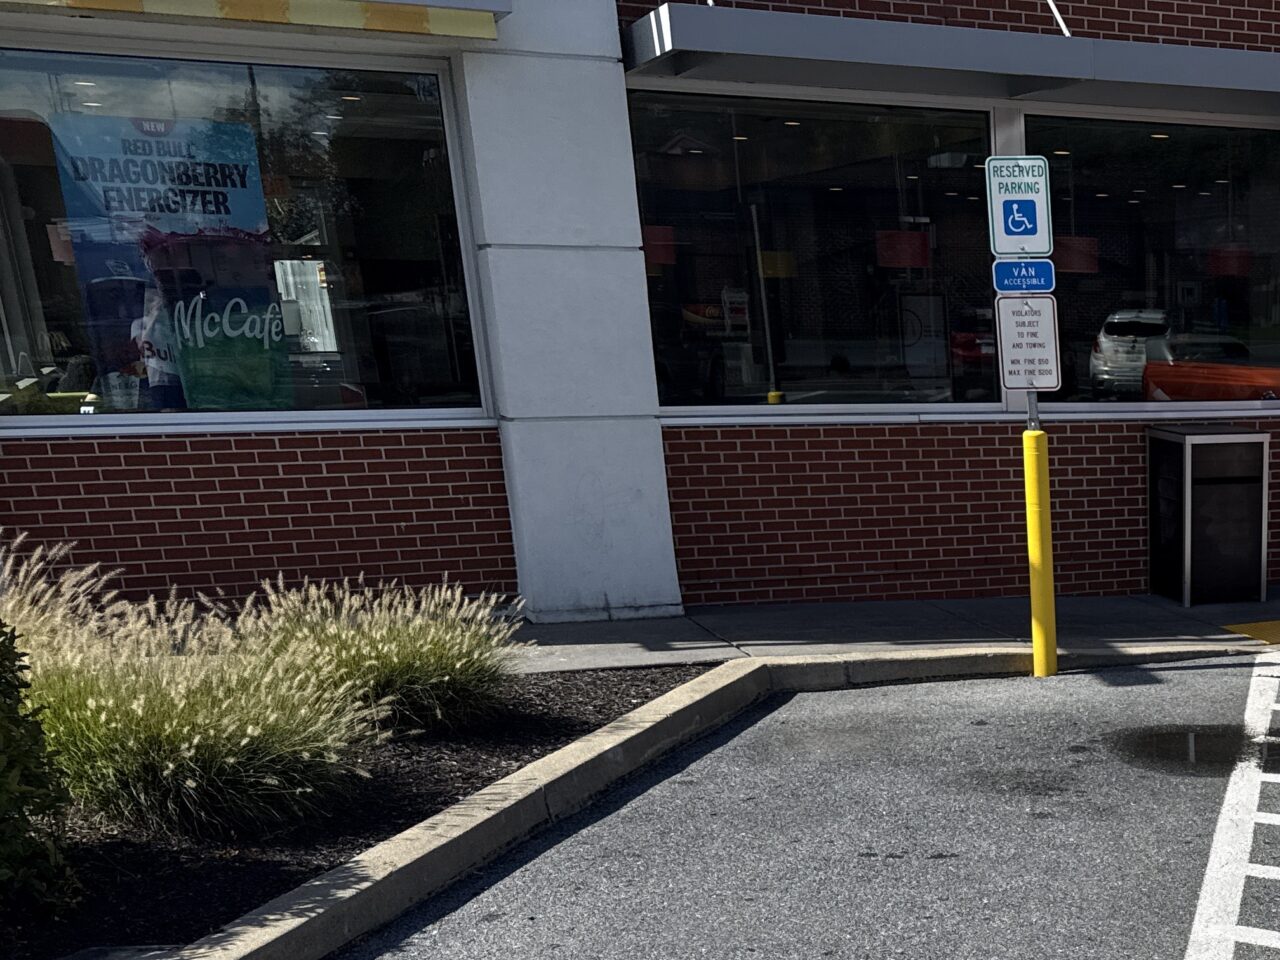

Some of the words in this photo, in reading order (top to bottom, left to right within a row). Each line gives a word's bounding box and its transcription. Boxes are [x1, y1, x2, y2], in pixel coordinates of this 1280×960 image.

[142, 120, 165, 132] NEW
[121, 138, 152, 155] RED
[156, 140, 196, 159] BULL
[71, 156, 249, 189] DRAGONBERRY
[992, 165, 1044, 178] RESERVED
[998, 182, 1040, 194] PARKING
[103, 186, 231, 215] ENERGIZER
[1012, 267, 1036, 277] VAN
[1003, 278, 1046, 286] ACCESSIBLE
[1011, 309, 1042, 317] VIOLATORS
[174, 294, 283, 350] McCafé
[1015, 320, 1040, 328] SUBJECT
[1017, 331, 1025, 339] TO
[1026, 331, 1040, 339] FINE
[1012, 342, 1024, 350] AND
[1025, 342, 1046, 350] TOWING
[1024, 358, 1037, 366] FINE
[1024, 368, 1037, 377] FINE
